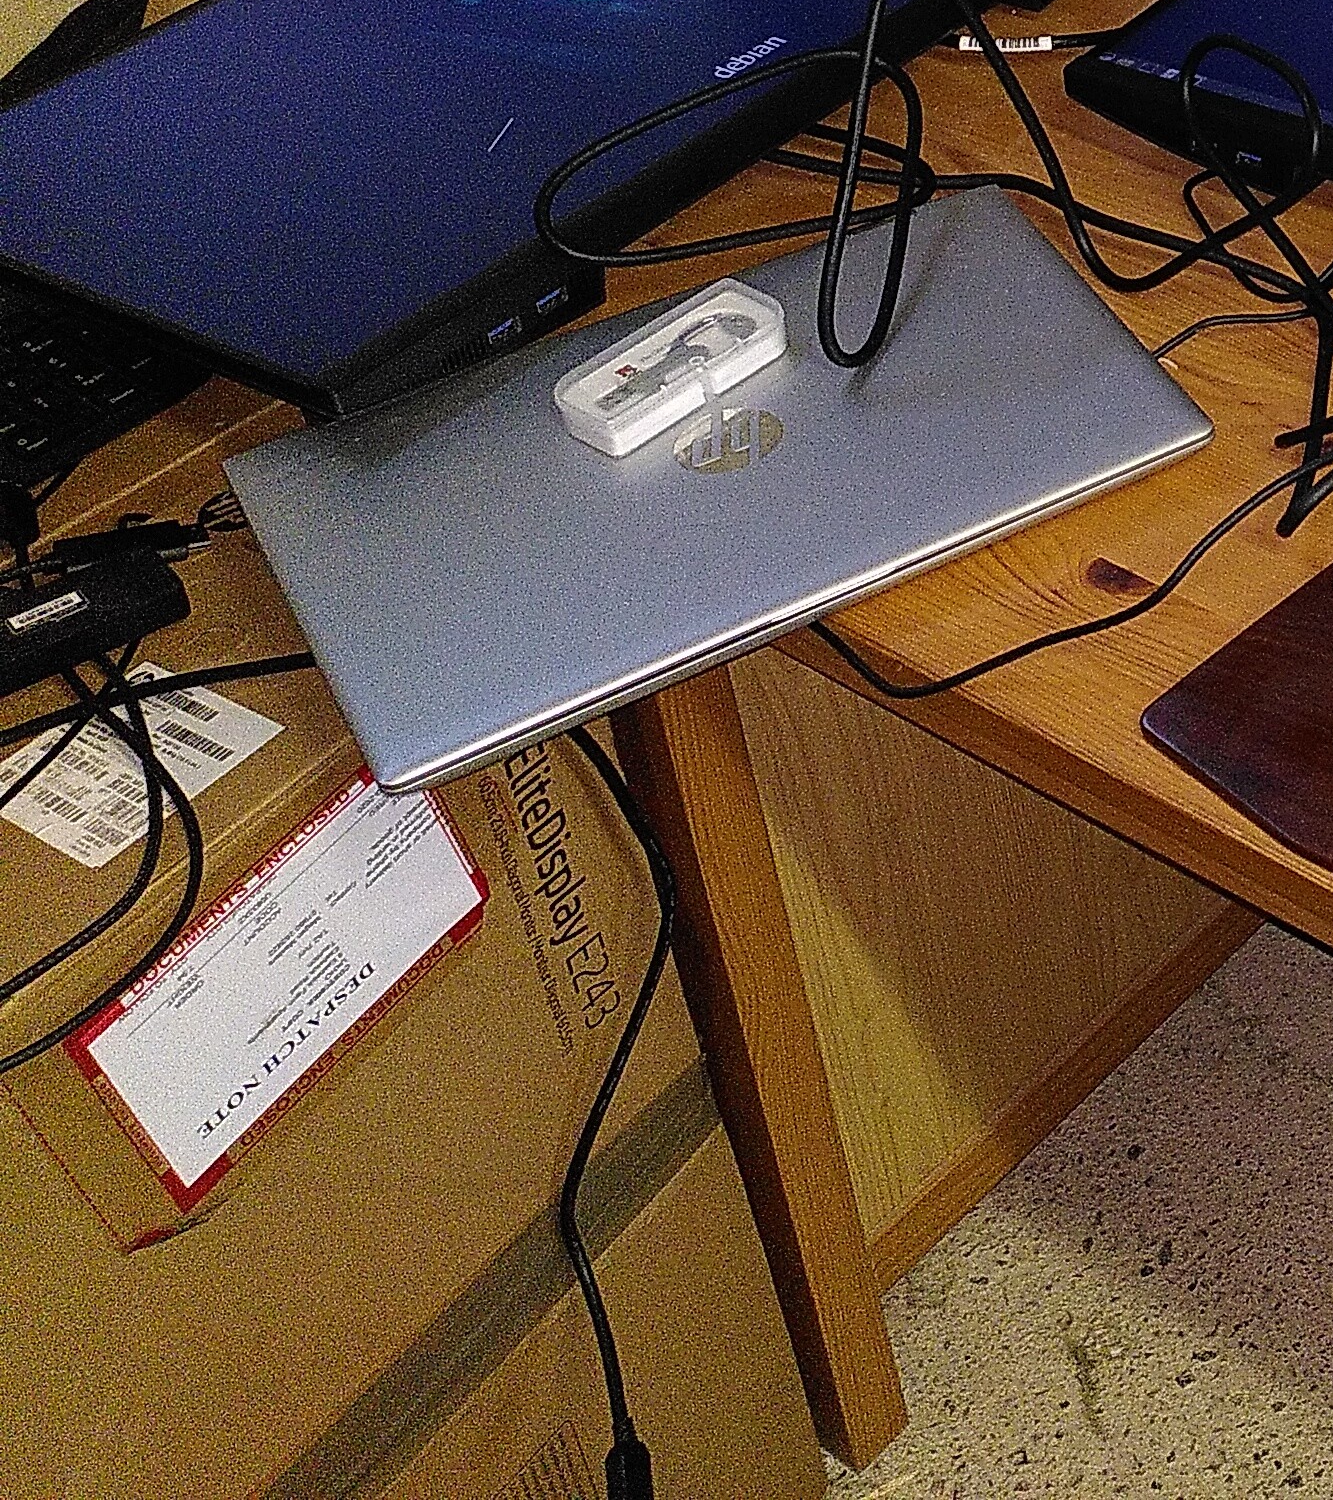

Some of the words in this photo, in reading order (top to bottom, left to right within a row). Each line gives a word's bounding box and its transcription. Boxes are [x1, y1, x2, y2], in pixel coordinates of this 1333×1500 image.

[714, 36, 788, 79] debian
[130, 880, 249, 995] DOCUMENTS
[253, 789, 352, 878] ENCLOSED
[504, 742, 589, 947] EliteDisplay
[565, 931, 620, 1030] E243
[263, 960, 376, 1078] DESPATCH
[341, 942, 446, 1050] DOCUMENTS
[196, 1076, 262, 1141] NOTE
[239, 1053, 339, 1149] ENCLOSED
